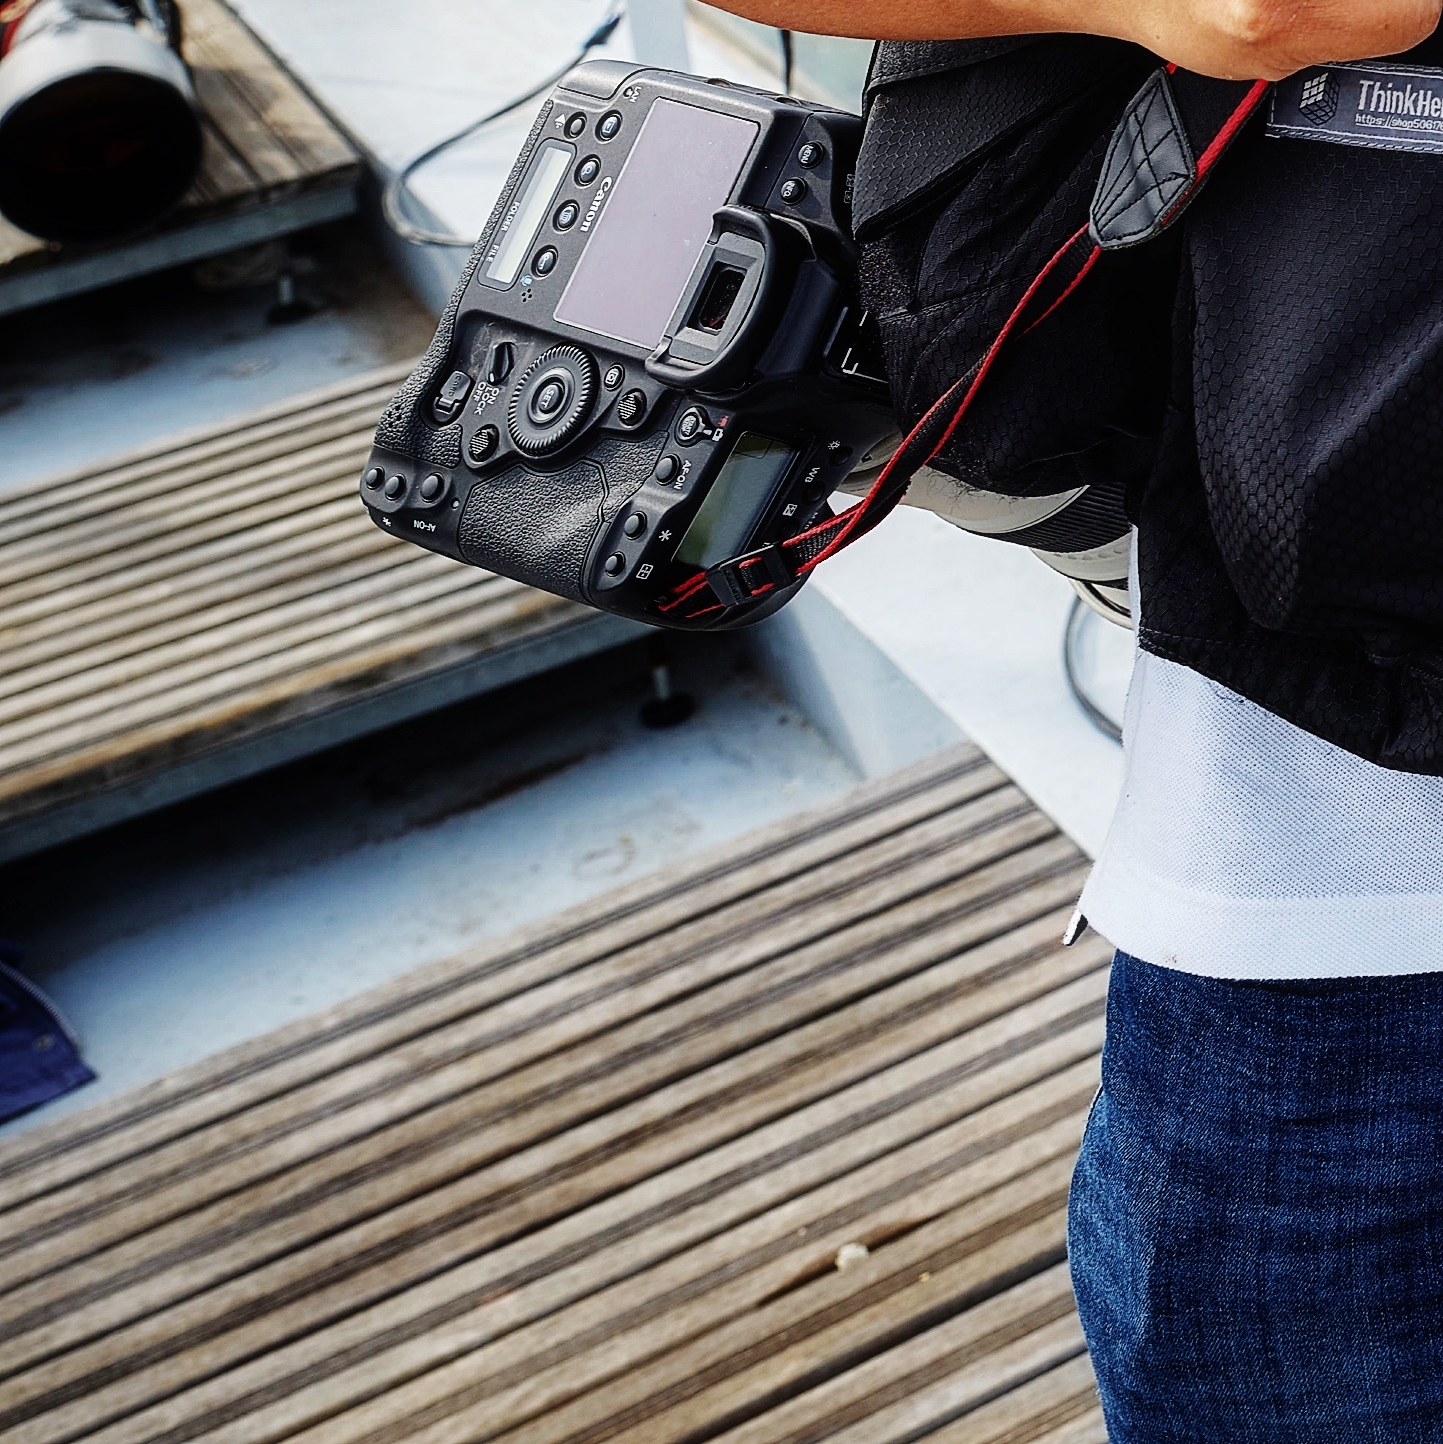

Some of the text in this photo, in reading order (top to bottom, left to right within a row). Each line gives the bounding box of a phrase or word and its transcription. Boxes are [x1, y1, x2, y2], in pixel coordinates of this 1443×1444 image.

[799, 144, 815, 165] MENU
[579, 175, 614, 233] Canon
[486, 201, 521, 264] FOLDER FILE
[473, 381, 487, 403] OFF
[474, 386, 495, 416] LOCK
[486, 387, 500, 406] ON
[540, 389, 555, 409] SET
[673, 459, 692, 490] AF-ON
[804, 467, 821, 484] WB
[413, 519, 437, 533] AF-ON
